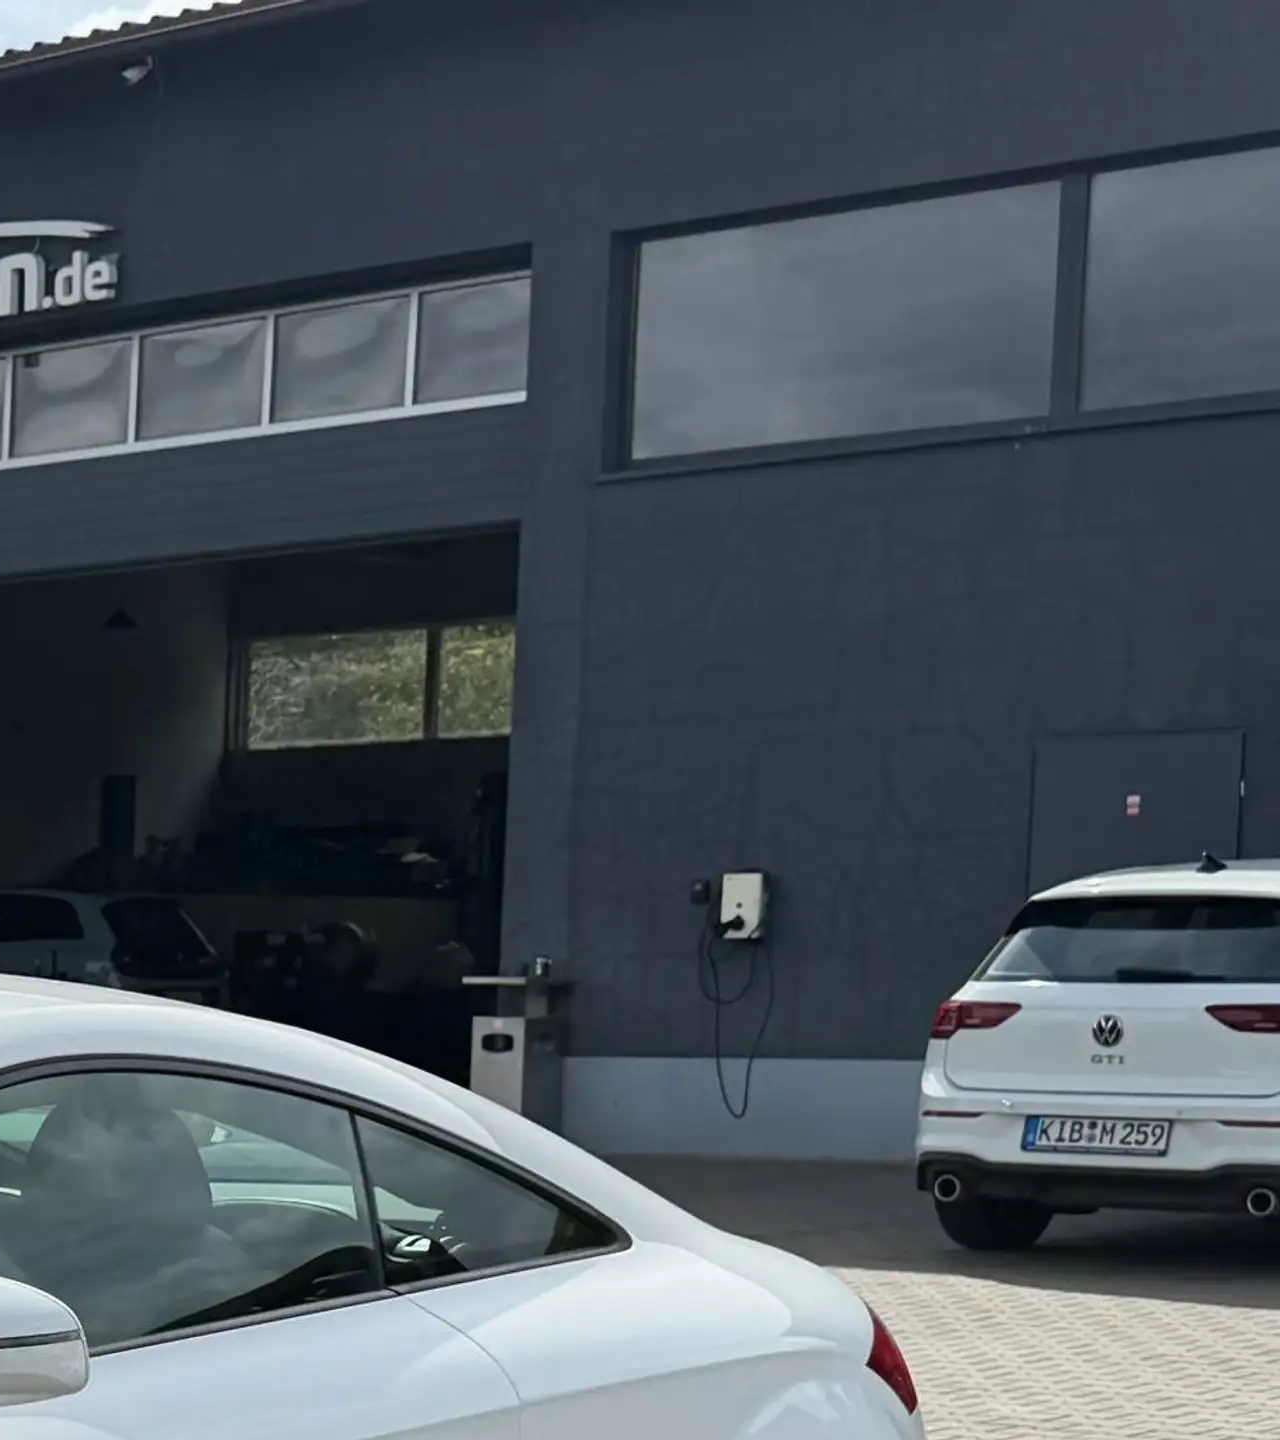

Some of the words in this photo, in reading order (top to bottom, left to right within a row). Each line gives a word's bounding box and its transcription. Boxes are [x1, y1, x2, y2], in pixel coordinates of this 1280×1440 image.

[1090, 1053, 1126, 1065] GTI
[1038, 1119, 1083, 1144] KIB
[1099, 1122, 1117, 1145] M
[1119, 1122, 1165, 1147] 259
